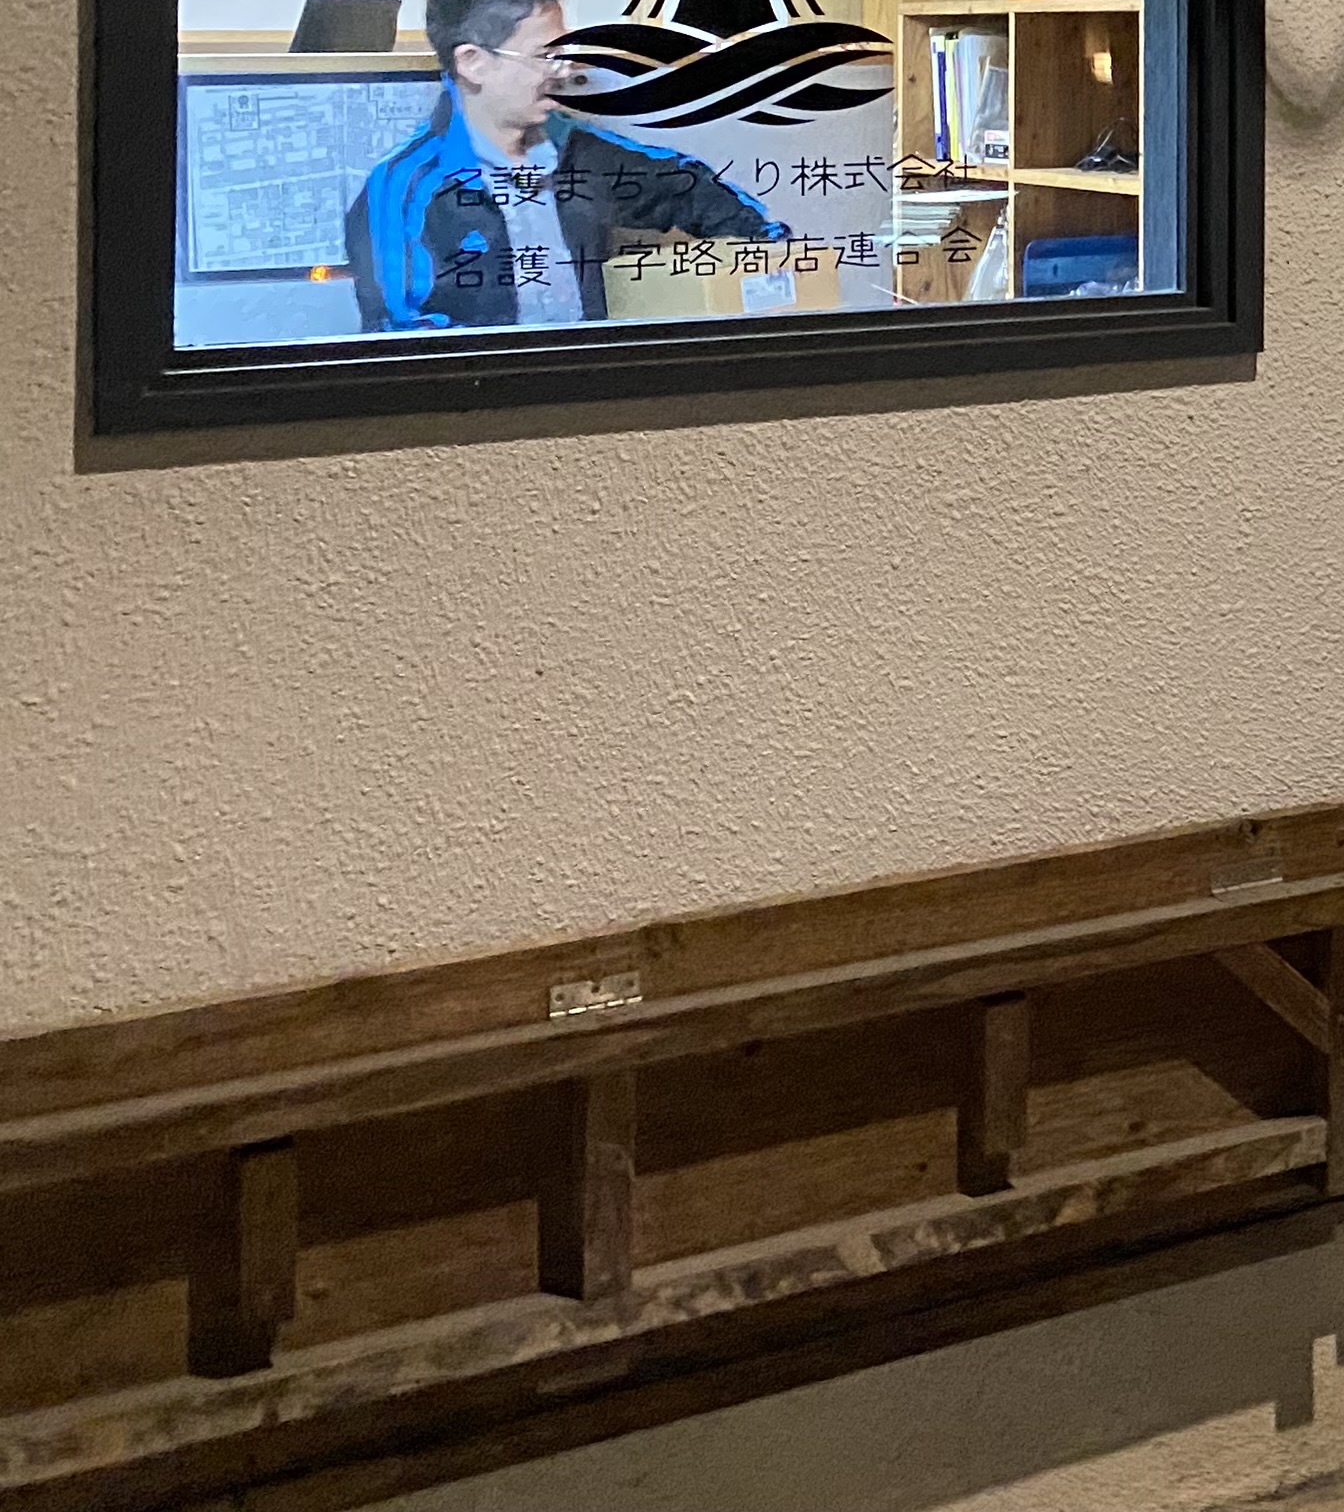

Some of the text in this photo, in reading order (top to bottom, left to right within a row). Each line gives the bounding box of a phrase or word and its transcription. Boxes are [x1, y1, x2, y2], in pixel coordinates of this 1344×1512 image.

[436, 226, 982, 288] 名護十字路商店連合会
